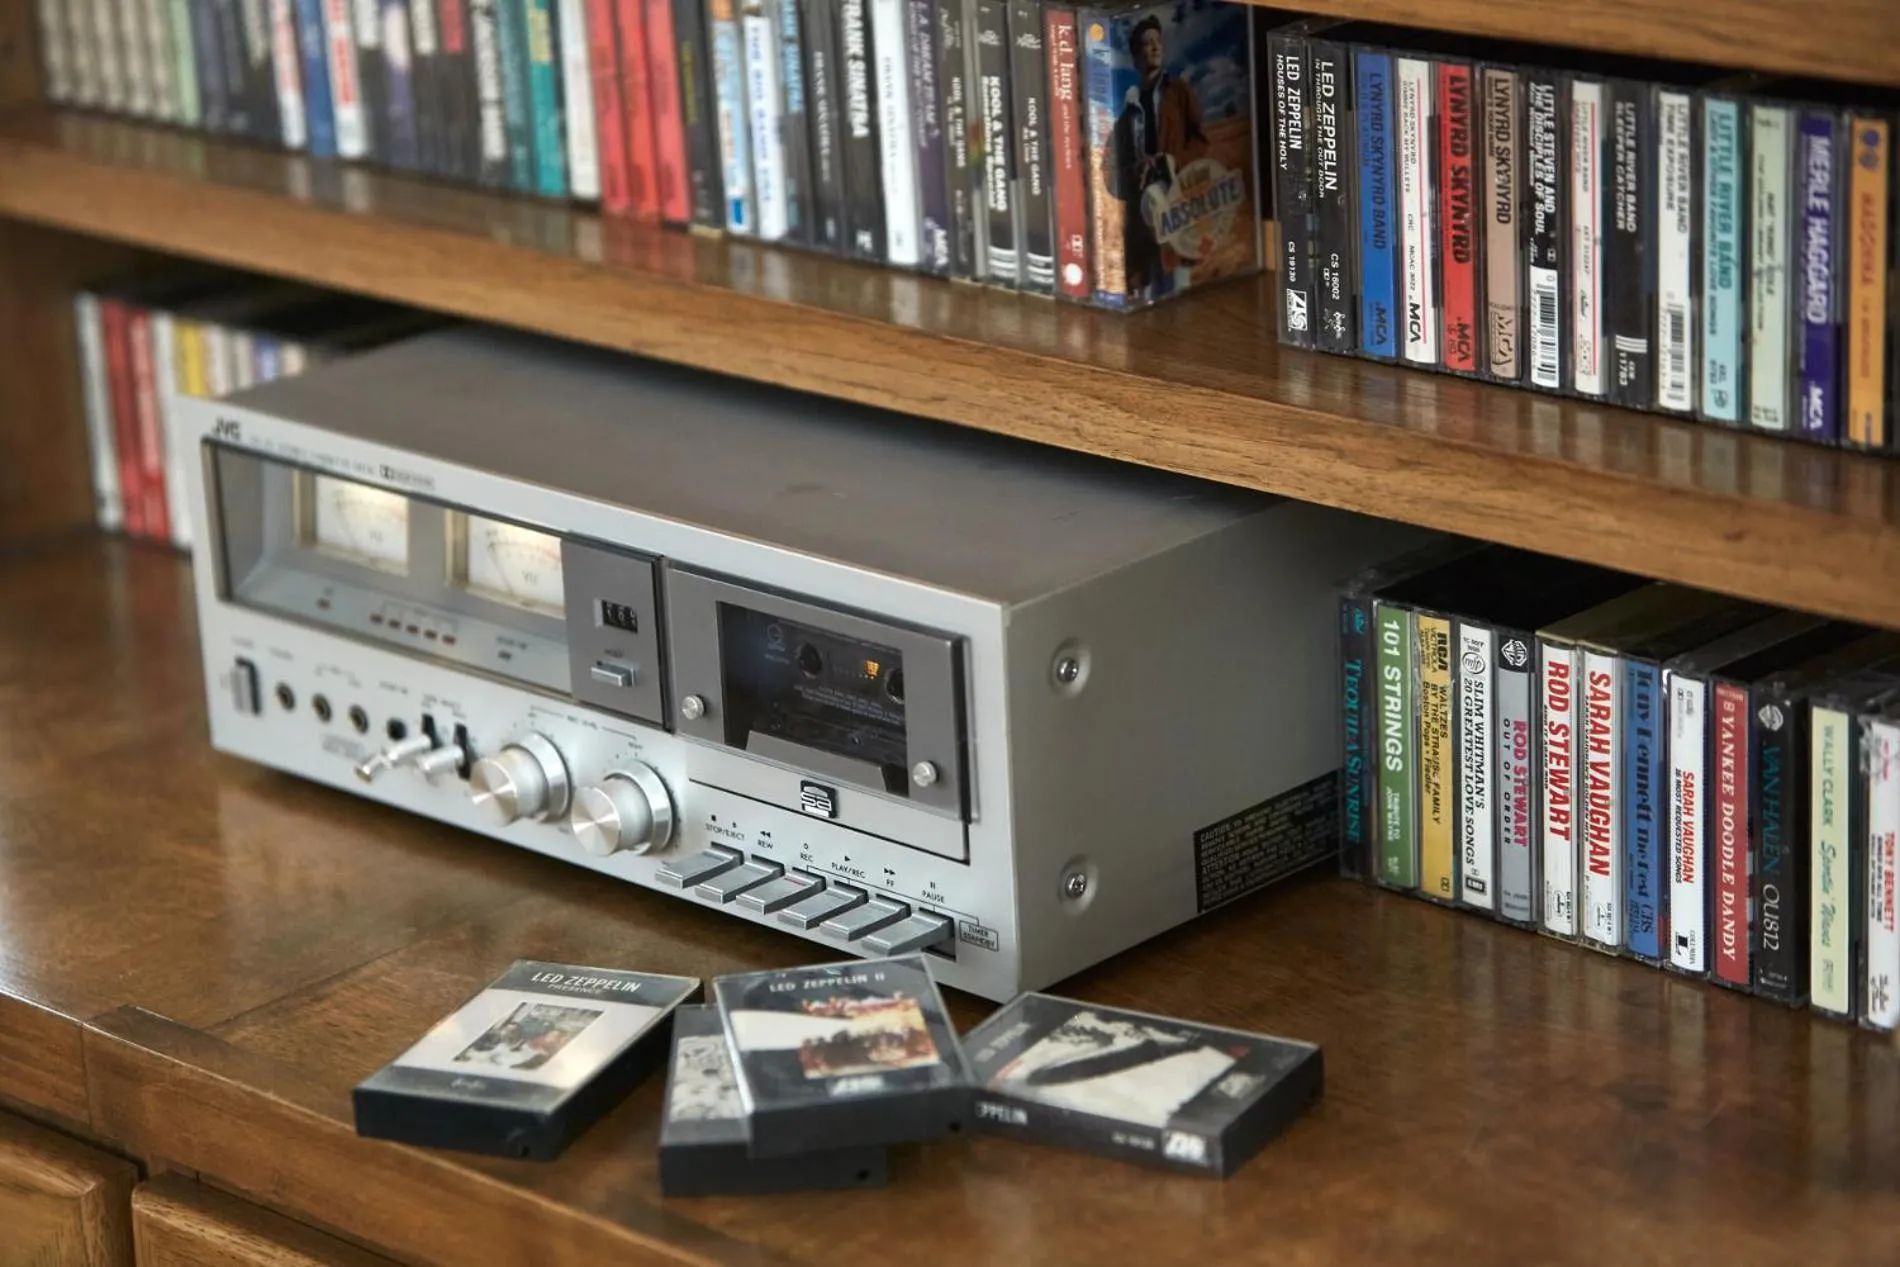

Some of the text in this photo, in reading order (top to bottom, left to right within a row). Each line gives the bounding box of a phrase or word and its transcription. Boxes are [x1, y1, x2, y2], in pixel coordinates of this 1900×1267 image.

[847, 59, 869, 137] SINATRA
[1027, 98, 1037, 127] KOOL
[1057, 63, 1074, 100] lang
[1276, 54, 1288, 170] HOUSES OF THE HOLY
[1285, 56, 1302, 149] LED ZEPPELIN
[1315, 69, 1323, 122] THROUGH
[988, 76, 1007, 211] KOOL & THE GANG
[1030, 140, 1040, 161] THE
[1321, 61, 1337, 191] LED ZEPPELIN
[1369, 72, 1387, 250] LYNYRD SKYNYRD BAND
[1494, 78, 1513, 224] LYNYRD SKYNYRD
[1535, 84, 1546, 235] THE DISCIPLES OF SOUL
[1543, 85, 1556, 214] LITTLE STEVEN AND
[1666, 102, 1675, 211] TIME EXPOSURE
[1032, 163, 1042, 195] GANG
[1449, 76, 1472, 265] LYNYRD SKYNYRD
[1615, 101, 1625, 230] SLEEPER CATCHER
[1625, 102, 1638, 233] LITTLE RIVER BAND
[1676, 103, 1688, 235] LITTLE RIVER BAND
[1718, 113, 1734, 290] LITTLE RIVER BAND
[1288, 242, 1295, 253] CS
[1330, 253, 1339, 268] CS
[1806, 135, 1831, 324] MERLE HAGGARD
[1376, 306, 1387, 345] MCA
[1409, 302, 1422, 344] MCA
[1457, 322, 1471, 363] MCA
[1437, 632, 1449, 672] RCA
[1383, 619, 1403, 772] 101 STRINGS
[1422, 680, 1431, 718] Boston
[1422, 720, 1431, 747] Pops
[1439, 685, 1449, 739] WALTZES
[1503, 718, 1511, 750] OUT
[1589, 670, 1612, 755] SARAH
[1424, 757, 1432, 795] Fiedler
[1430, 683, 1441, 826] BY THE FAMILY
[1464, 678, 1475, 865] 20 GREATEST LOVE SONGS
[1474, 680, 1486, 810] SLIM WHITMAN'S
[1504, 760, 1511, 781] OF
[1513, 720, 1529, 847] ROD STEWART
[1548, 660, 1571, 842] ROD STEWART
[1676, 768, 1682, 777] 16
[1722, 716, 1735, 797] YANKEE
[1823, 724, 1834, 777] WALLY
[705, 822, 745, 841] STOP/EJECT
[1589, 760, 1612, 877] VAUGHAN
[1682, 771, 1694, 884] SARAH VAUGHAN
[1822, 778, 1834, 828] CLARK
[757, 839, 774, 849] REW
[800, 852, 814, 863] REC
[831, 862, 866, 879] PLAY/REC
[1722, 801, 1736, 886] DOODLE
[1762, 746, 1782, 951] VAN HALEN OU812
[1884, 832, 1896, 932] TONY BENNETT
[922, 890, 945, 903] PAUSE
[1722, 890, 1736, 962] DANDY
[531, 971, 642, 993] LED ZEPPELIN
[769, 971, 886, 993] LED ZEPPELIN II
